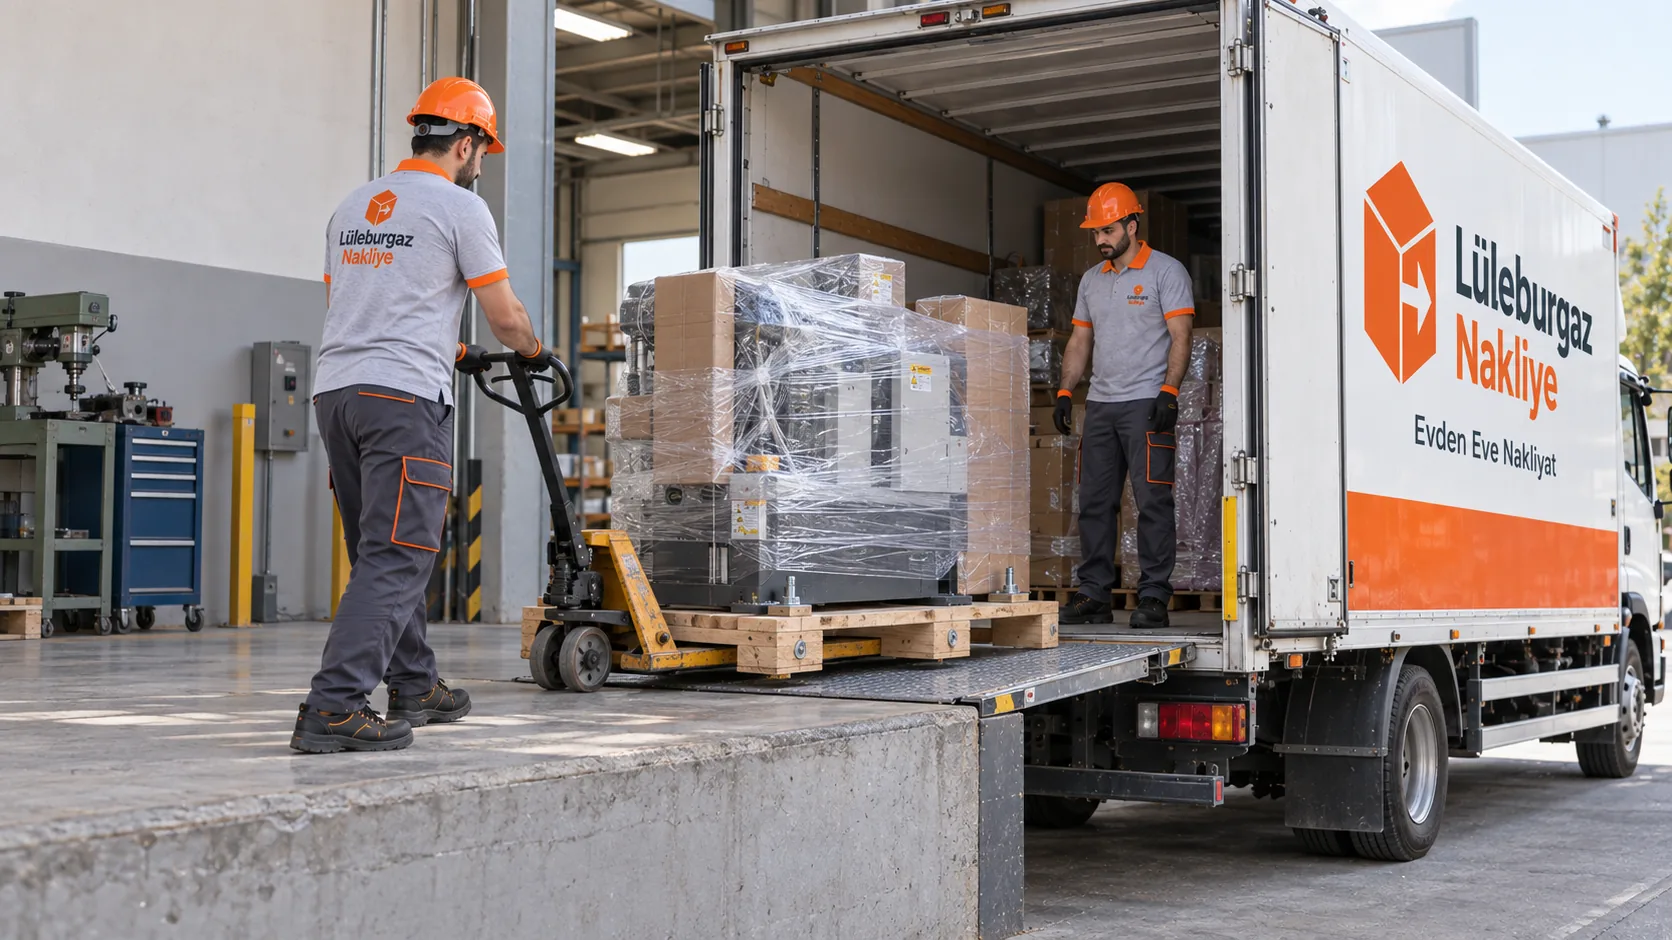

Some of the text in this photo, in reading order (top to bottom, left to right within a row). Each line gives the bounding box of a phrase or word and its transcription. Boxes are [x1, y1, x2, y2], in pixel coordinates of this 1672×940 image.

[340, 229, 414, 249] Lüleburgaz
[342, 249, 394, 268] Nakliye
[1456, 224, 1593, 358] Lüleburgaz
[1456, 313, 1558, 420] Nakliye
[1415, 414, 1557, 480] Evden Eve Nakliyat
